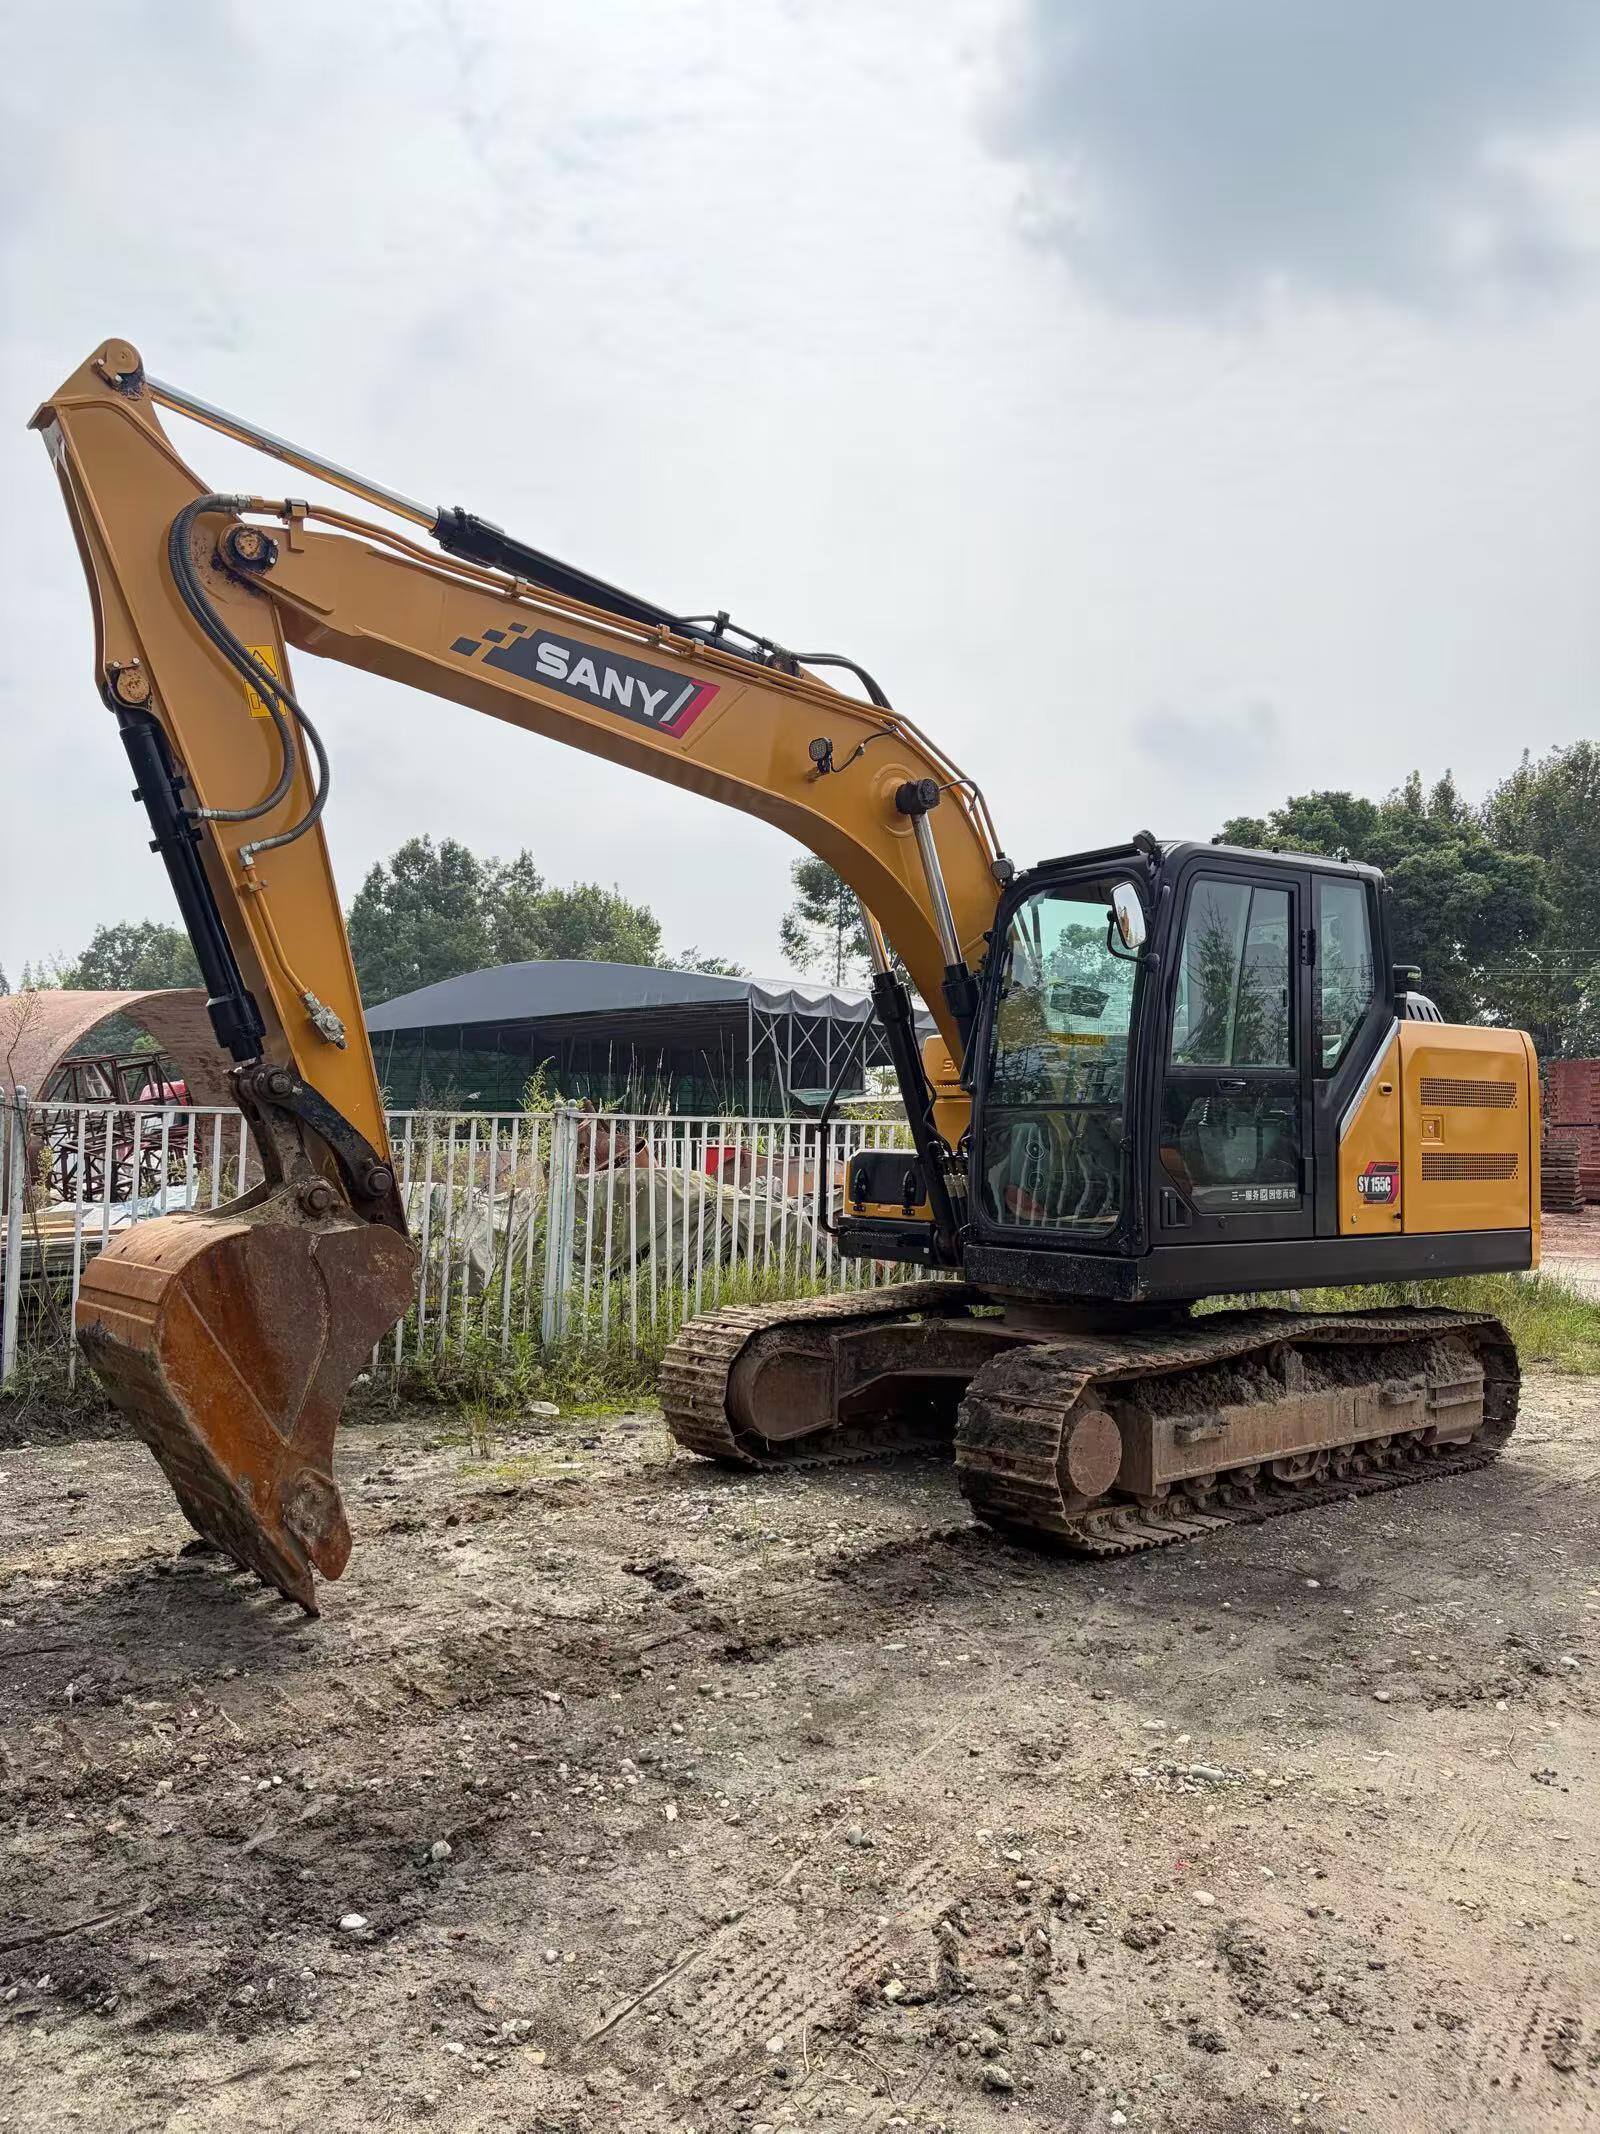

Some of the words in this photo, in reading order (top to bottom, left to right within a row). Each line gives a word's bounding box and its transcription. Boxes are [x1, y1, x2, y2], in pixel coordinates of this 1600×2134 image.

[536, 642, 669, 717] SANY
[1358, 1176, 1370, 1192] SY
[1370, 1176, 1391, 1192] 155C
